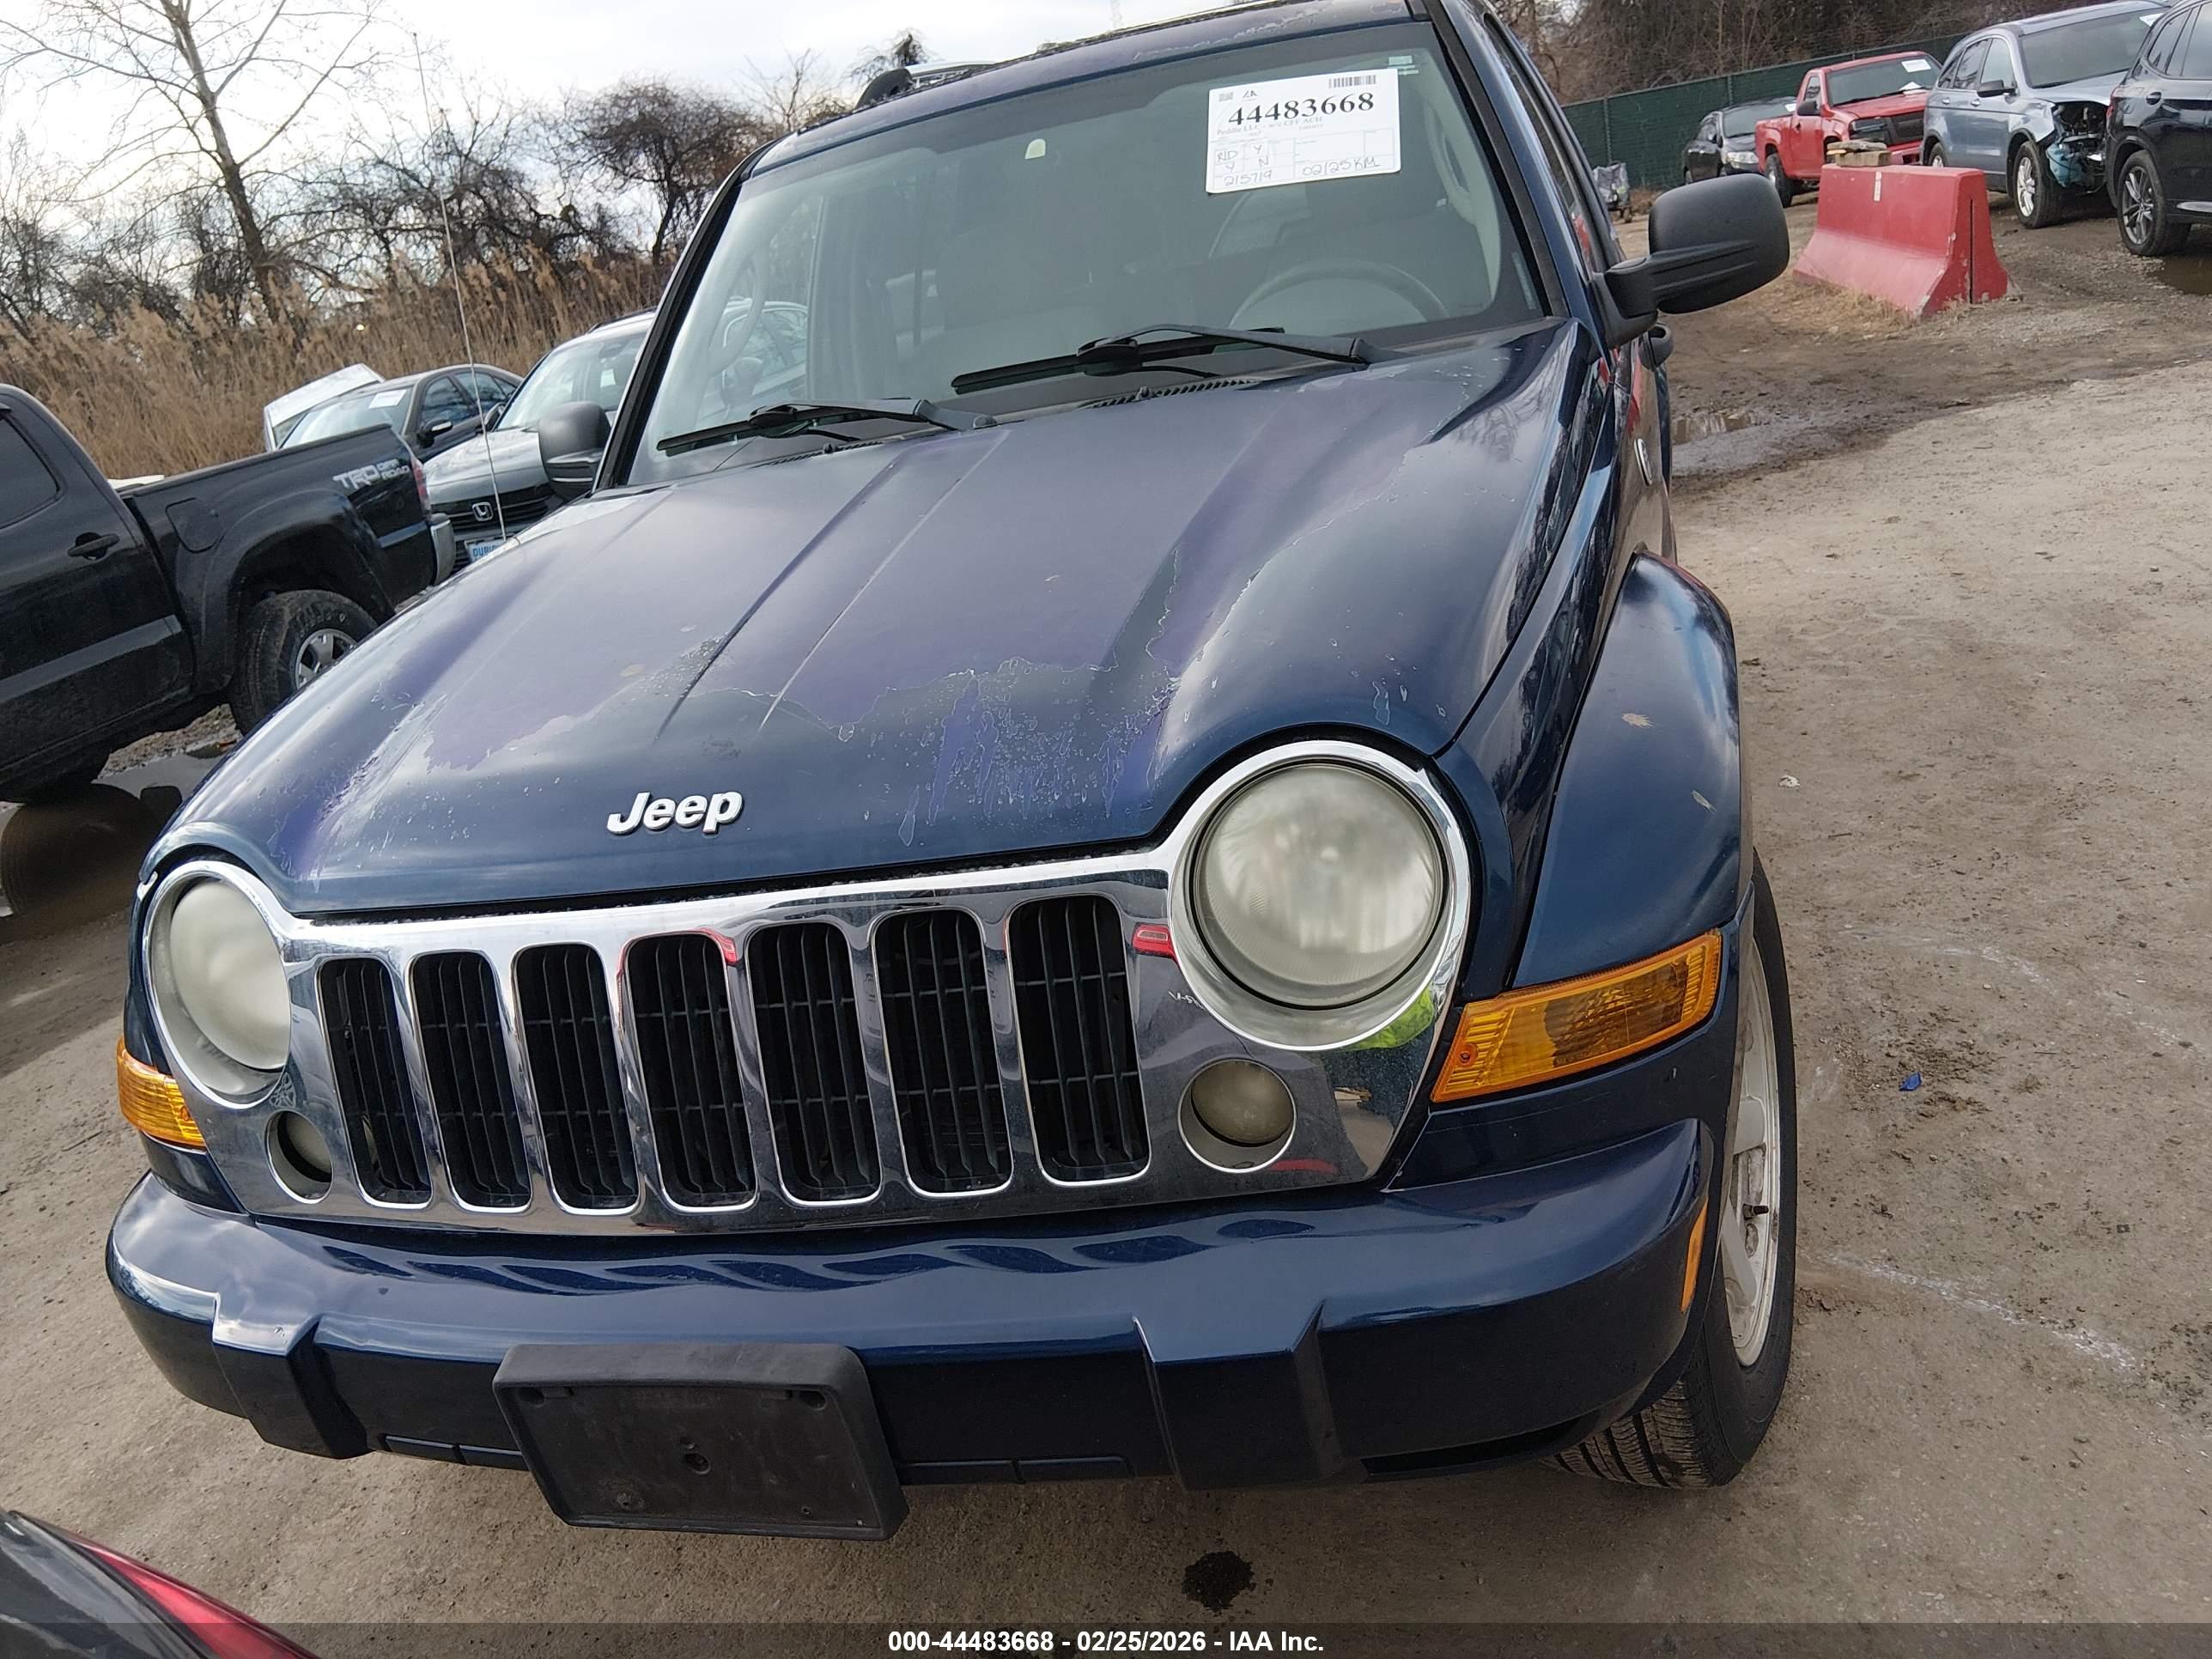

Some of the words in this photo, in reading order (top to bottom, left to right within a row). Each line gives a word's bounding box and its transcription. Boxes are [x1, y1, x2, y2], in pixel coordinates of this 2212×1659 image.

[1228, 92, 1374, 125] 44483668
[1258, 155, 1269, 167] N
[332, 465, 380, 489] TRD
[606, 791, 743, 834] Jeep
